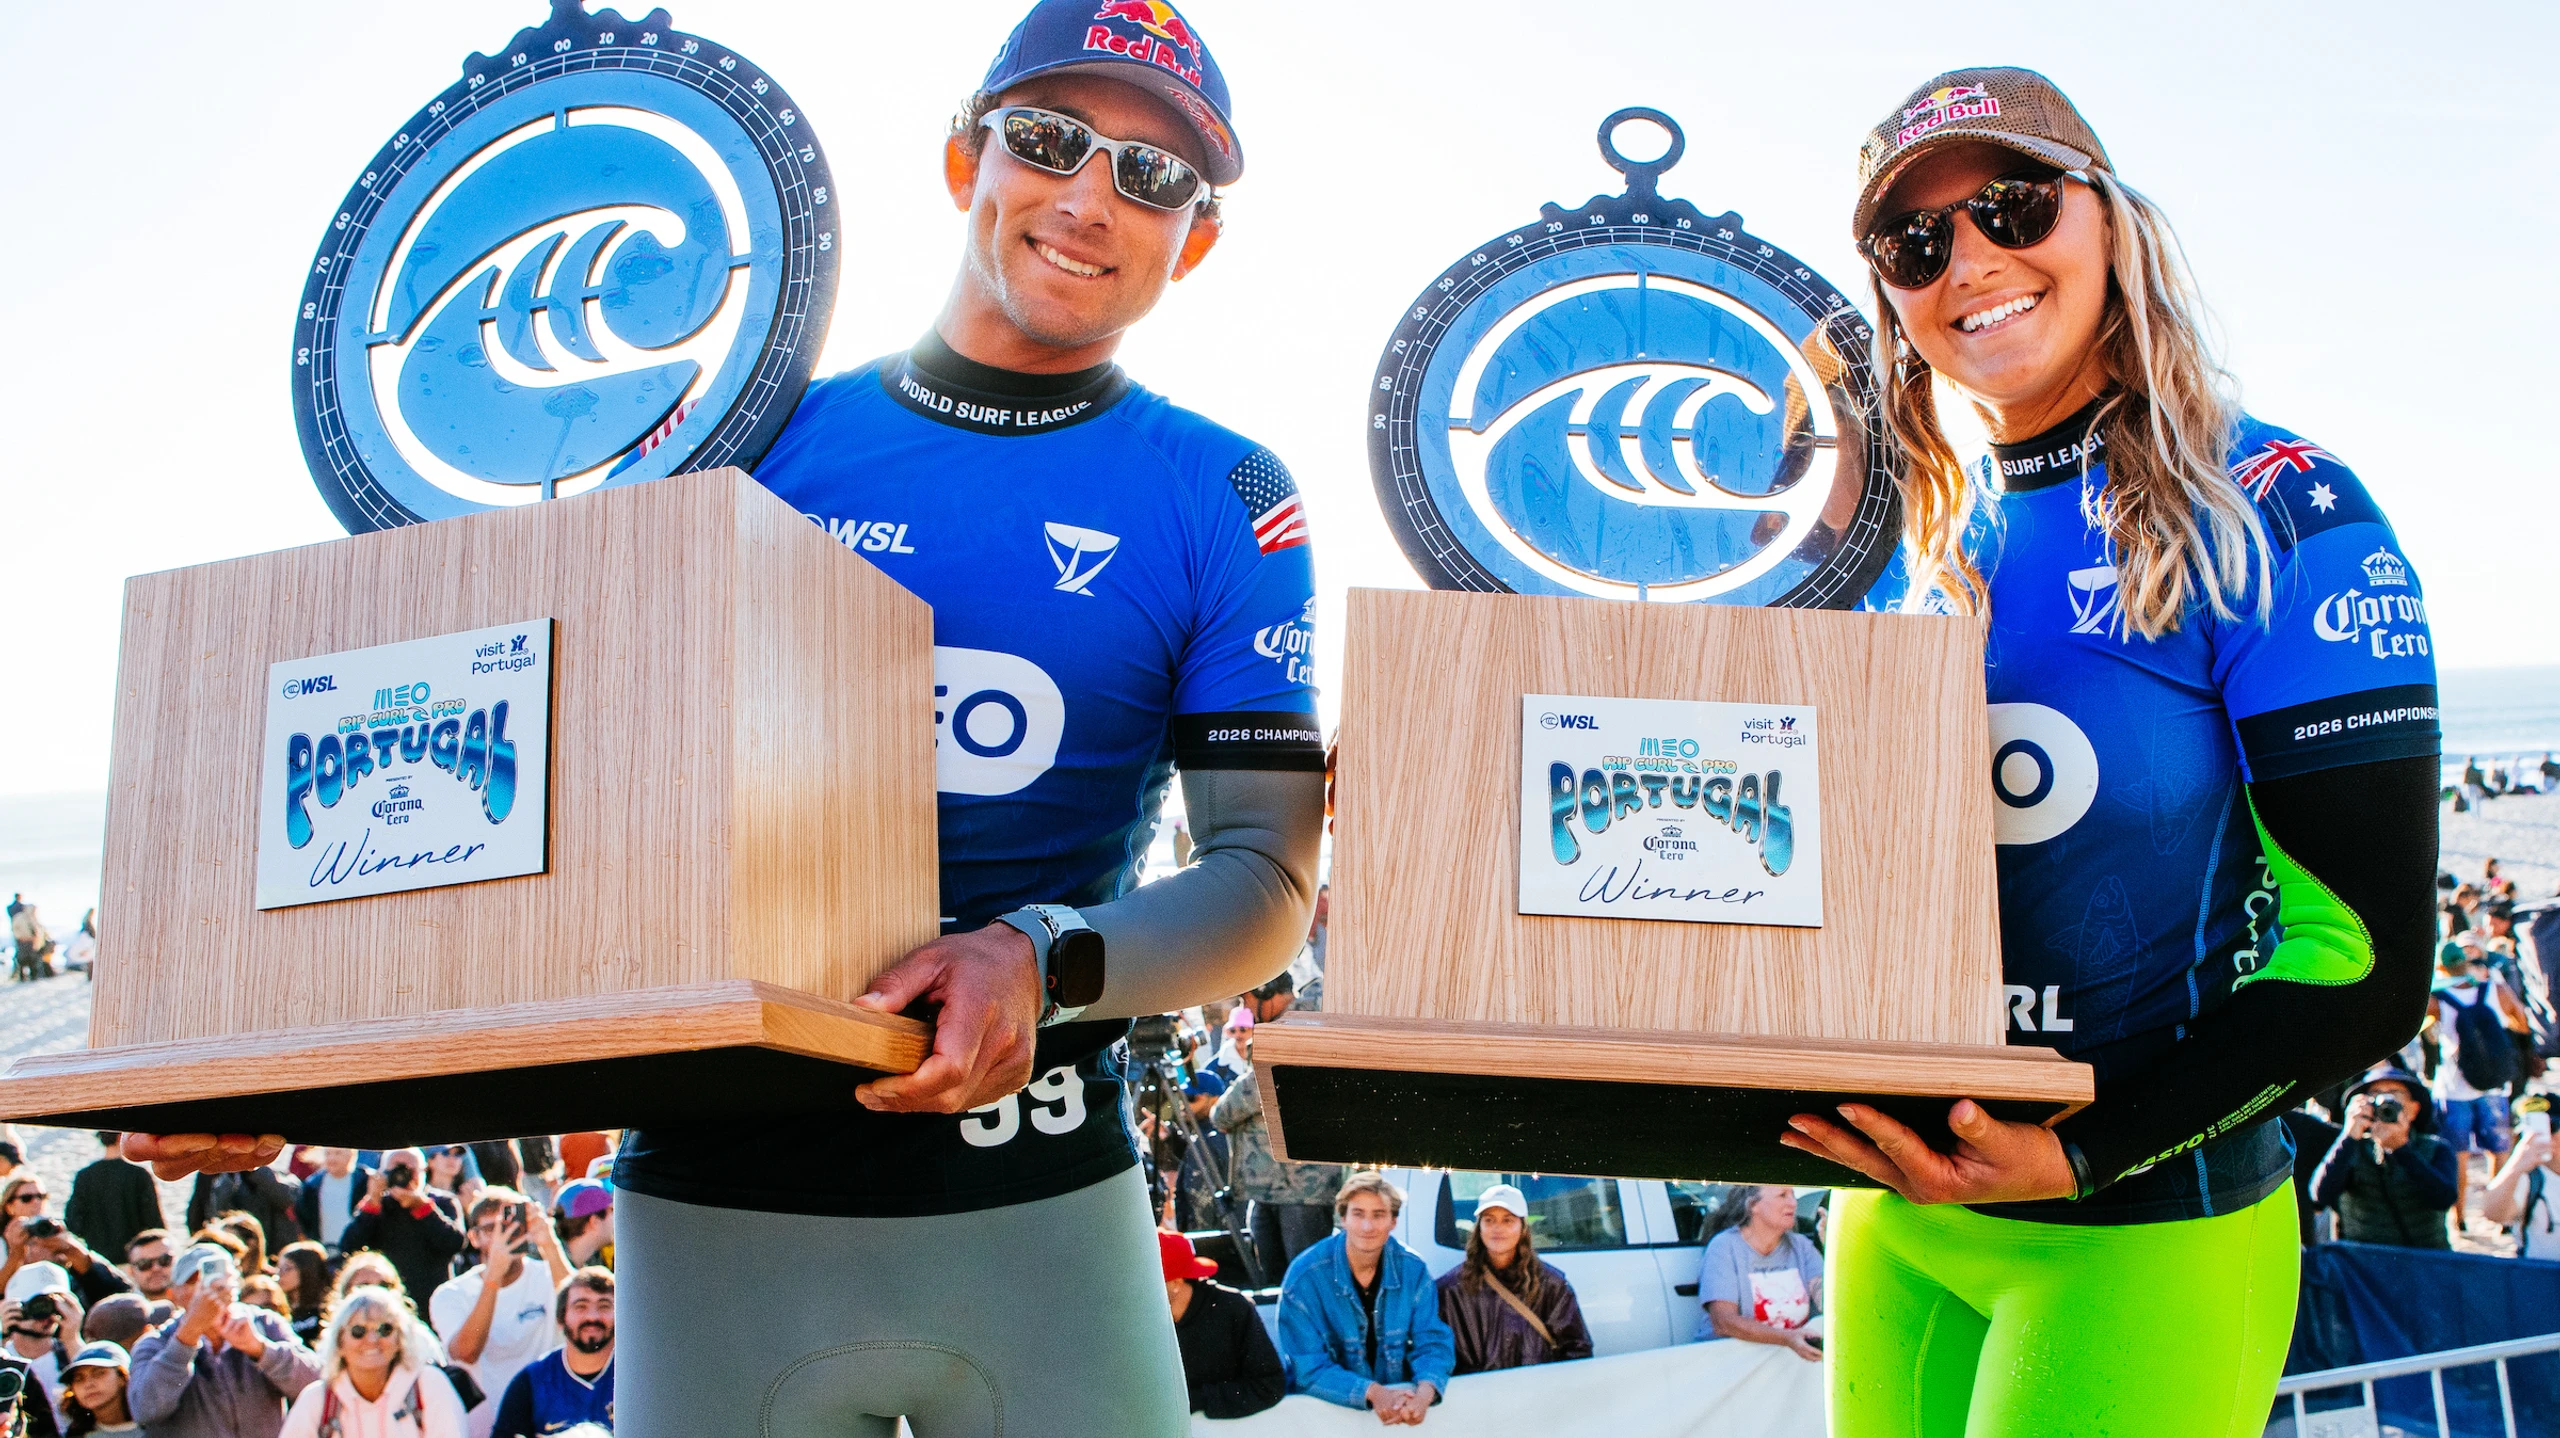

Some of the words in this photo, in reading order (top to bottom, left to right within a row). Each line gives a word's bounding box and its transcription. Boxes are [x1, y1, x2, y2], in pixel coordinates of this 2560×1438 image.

[554, 38, 571, 52] 00
[598, 32, 615, 44] 10
[640, 31, 658, 45] 20
[680, 39, 699, 55] 30
[1083, 24, 1154, 62] Red
[511, 52, 527, 67] 10
[718, 55, 736, 71] 40
[468, 73, 485, 90] 20
[751, 77, 769, 95] 50
[428, 100, 445, 118] 30
[778, 108, 796, 126] 60
[1896, 109, 1946, 147] Red
[1947, 97, 2001, 122] Bull
[393, 133, 409, 150] 40
[798, 143, 816, 163] 70
[360, 171, 377, 188] 50
[813, 185, 828, 205] 80
[335, 212, 351, 230] 60
[1546, 221, 1564, 233] 20
[1589, 214, 1605, 225] 10
[1632, 213, 1649, 224] 00
[1676, 217, 1692, 229] 10
[818, 231, 833, 251] 90
[1506, 234, 1524, 248] 30
[1717, 228, 1734, 241] 20
[1471, 252, 1487, 266] 40
[1756, 244, 1774, 258] 30
[315, 256, 330, 274] 70
[1794, 267, 1811, 281] 40
[1437, 277, 1455, 292] 50
[302, 302, 316, 319] 80
[1412, 306, 1428, 321] 60
[1854, 325, 1870, 340] 60
[1391, 338, 1408, 356] 70
[296, 347, 310, 366] 90
[1378, 375, 1393, 391] 80
[899, 371, 953, 414] WORLD
[955, 401, 1011, 426] SURF
[1015, 400, 1092, 427] LEAGUE
[1373, 413, 1387, 430] 90
[2001, 455, 2045, 477] SURF
[2047, 432, 2105, 469] LEAGU
[829, 517, 916, 555] WSL
[2313, 588, 2427, 644] Coron
[475, 641, 506, 658] visit
[472, 652, 537, 676] Portugal
[300, 674, 338, 695] WSL
[373, 681, 431, 711] MEO
[337, 714, 367, 735] RIP
[367, 708, 410, 729] CURL
[431, 698, 467, 720] PRO
[1560, 714, 1600, 730] WSL
[1743, 717, 1775, 730] visit
[1207, 728, 1251, 742] 2026
[2293, 718, 2343, 741] 2026
[1639, 737, 1700, 759] MEO
[1741, 731, 1806, 749] Portugal
[286, 698, 519, 850] PORTUGAL
[1602, 755, 1633, 771] RIP
[1634, 757, 1679, 773] CURL
[1701, 759, 1738, 775] PRO
[371, 797, 425, 819] Corona
[1547, 759, 1795, 878] PORTUGAL
[1642, 835, 1699, 854] Corona
[309, 827, 485, 888] Winner
[1578, 857, 1764, 905] Winner
